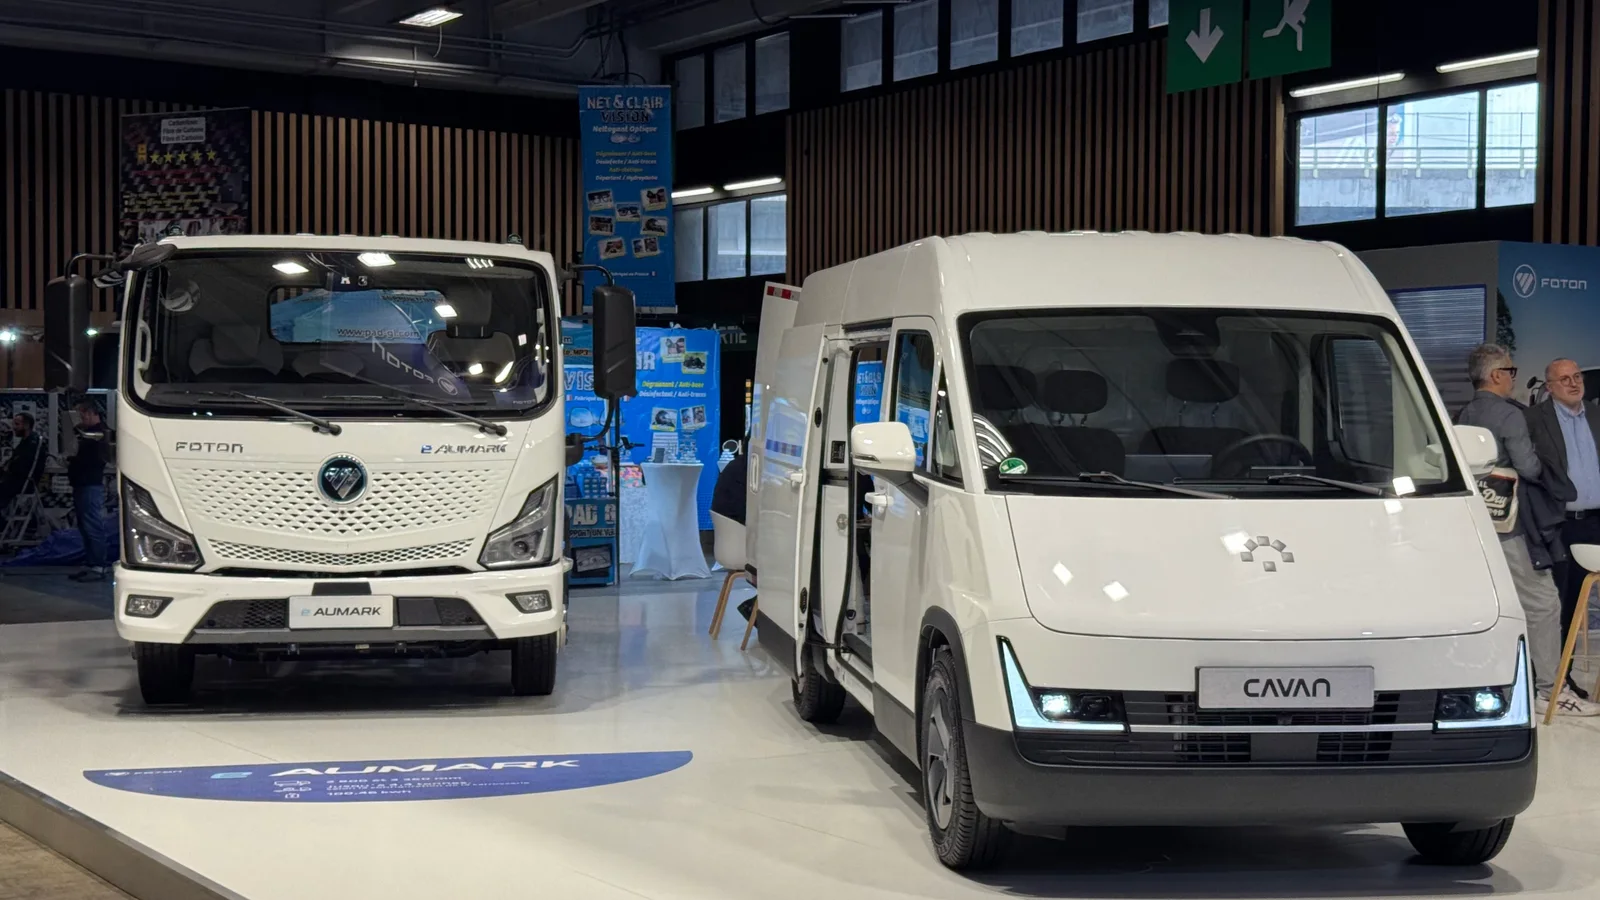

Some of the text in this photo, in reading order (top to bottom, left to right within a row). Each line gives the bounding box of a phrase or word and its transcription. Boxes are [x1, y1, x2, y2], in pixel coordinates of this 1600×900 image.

[587, 96, 611, 109] NET
[613, 94, 625, 109] &
[1540, 278, 1587, 290] FOTON
[175, 441, 244, 454] FOTON
[313, 606, 382, 617] AUMARK
[1243, 678, 1331, 698] CAVAN
[268, 759, 581, 777] AUMARK
